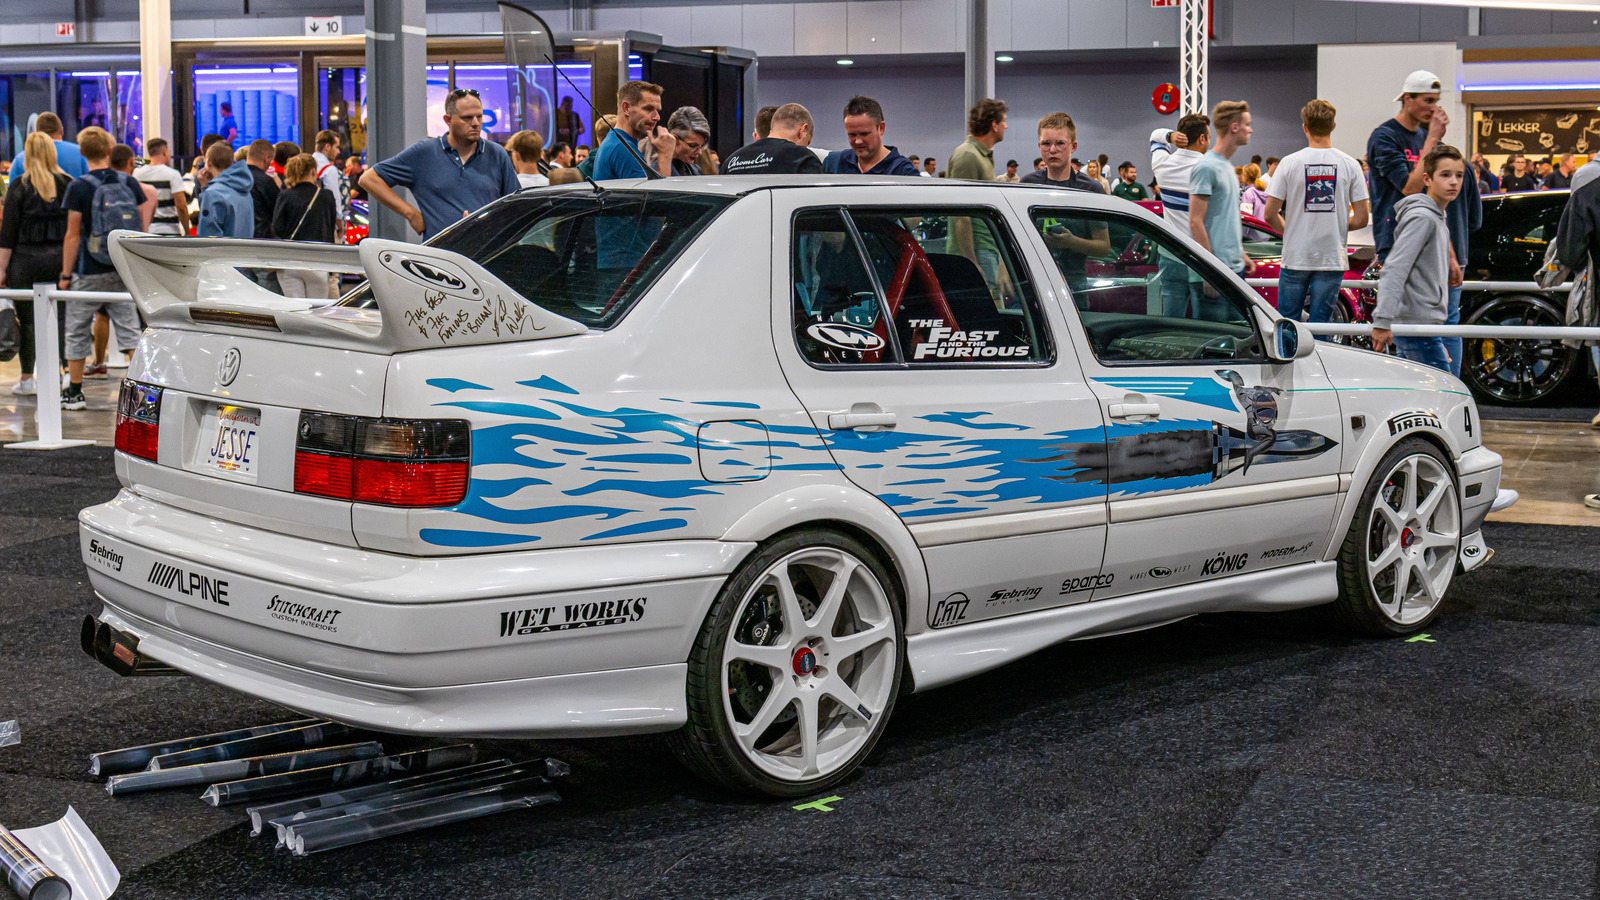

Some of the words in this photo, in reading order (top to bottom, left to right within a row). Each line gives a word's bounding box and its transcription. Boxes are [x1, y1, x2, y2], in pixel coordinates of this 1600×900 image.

[326, 21, 339, 33] 10
[1498, 122, 1540, 133] LEKKER
[1308, 168, 1334, 176] DENALI
[816, 315, 873, 324] WINGS
[908, 319, 944, 328] THE
[928, 327, 1000, 343] FAST
[823, 351, 879, 359] WEST
[914, 342, 1030, 359] FURIOUS
[1387, 411, 1443, 437] PIRELLI
[1463, 406, 1473, 438] 4
[211, 425, 256, 463] JESSE
[89, 539, 124, 572] Sebring
[89, 553, 117, 570] TUNING
[1200, 551, 1249, 576] KÖNIG
[148, 561, 230, 606] ALPINE
[1060, 573, 1115, 595] sparco
[985, 597, 1029, 608] TUNING
[986, 587, 1043, 602] Sebring
[266, 594, 342, 625] STITCHCRAFT
[500, 606, 556, 637] WET
[564, 597, 648, 622] WORKS
[271, 612, 299, 624] CUSTOM
[300, 619, 338, 633] INTERIORS
[520, 617, 624, 634] GARAGE
